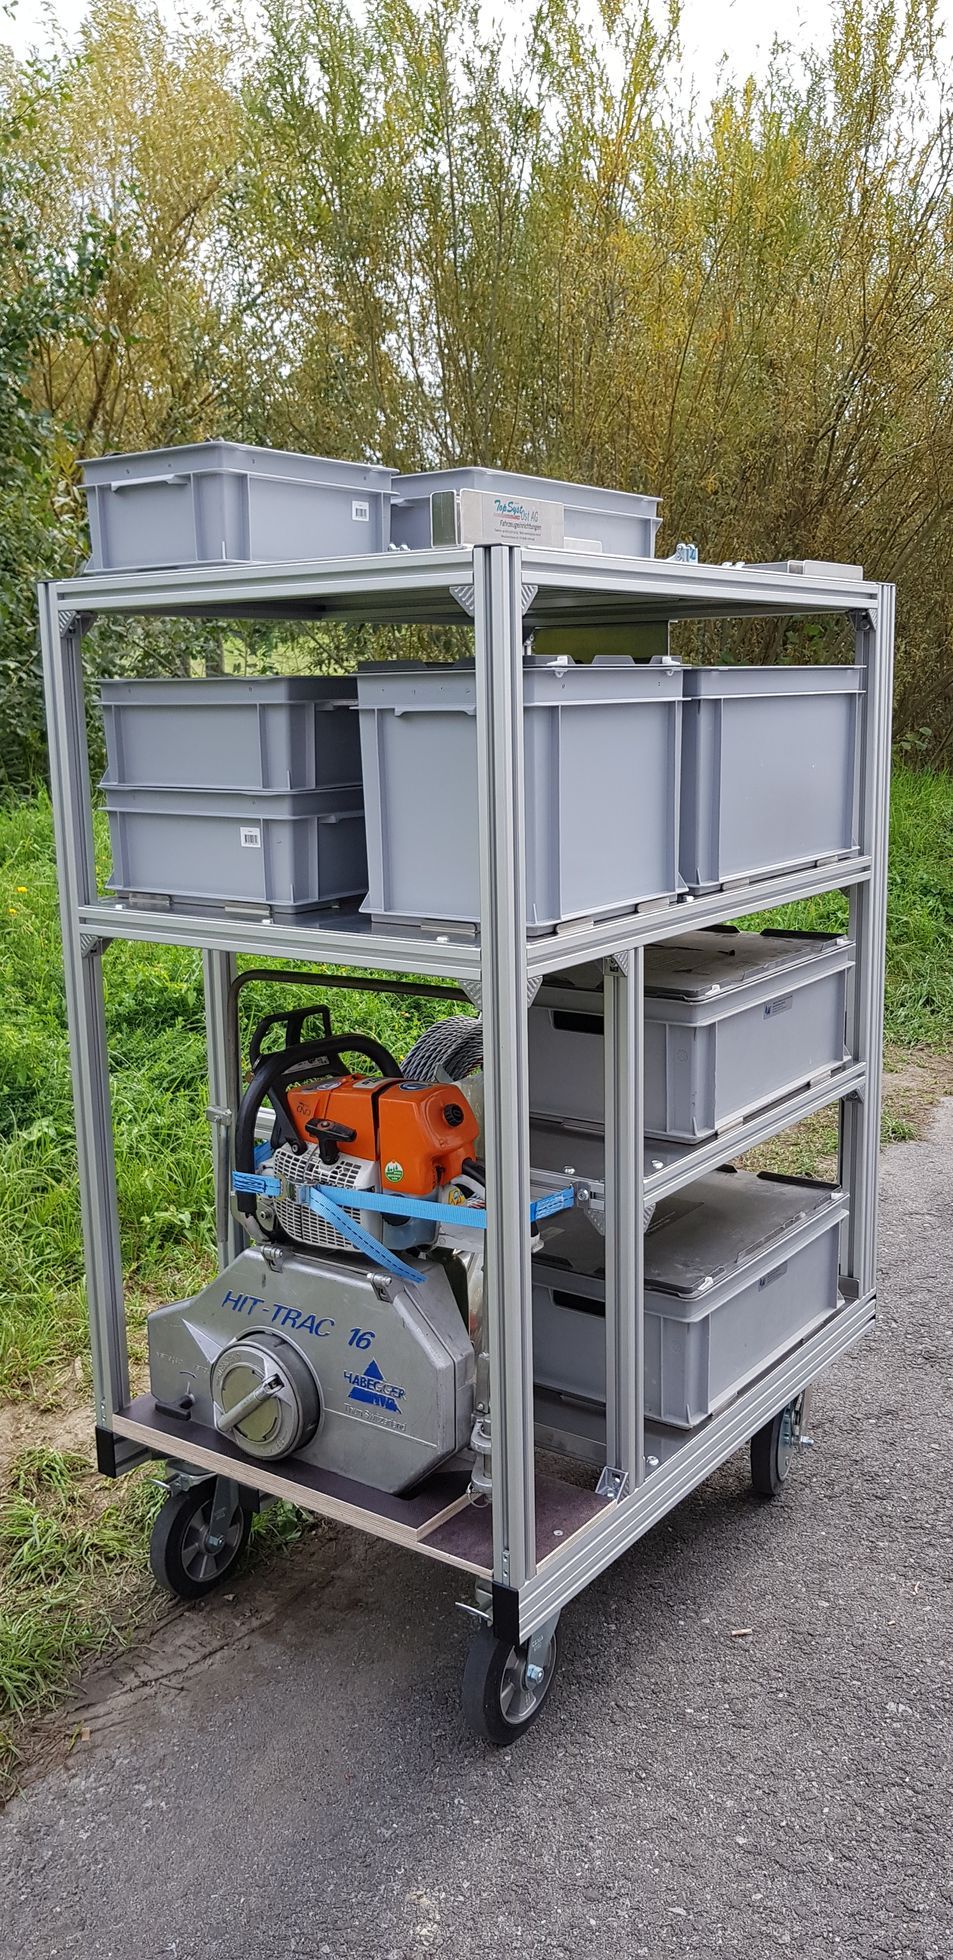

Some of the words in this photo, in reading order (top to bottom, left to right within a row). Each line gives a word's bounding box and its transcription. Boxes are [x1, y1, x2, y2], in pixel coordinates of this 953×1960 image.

[221, 1290, 335, 1337] HIT-TRAC
[348, 1327, 376, 1350] 16
[343, 1370, 407, 1400] HABEGGER
